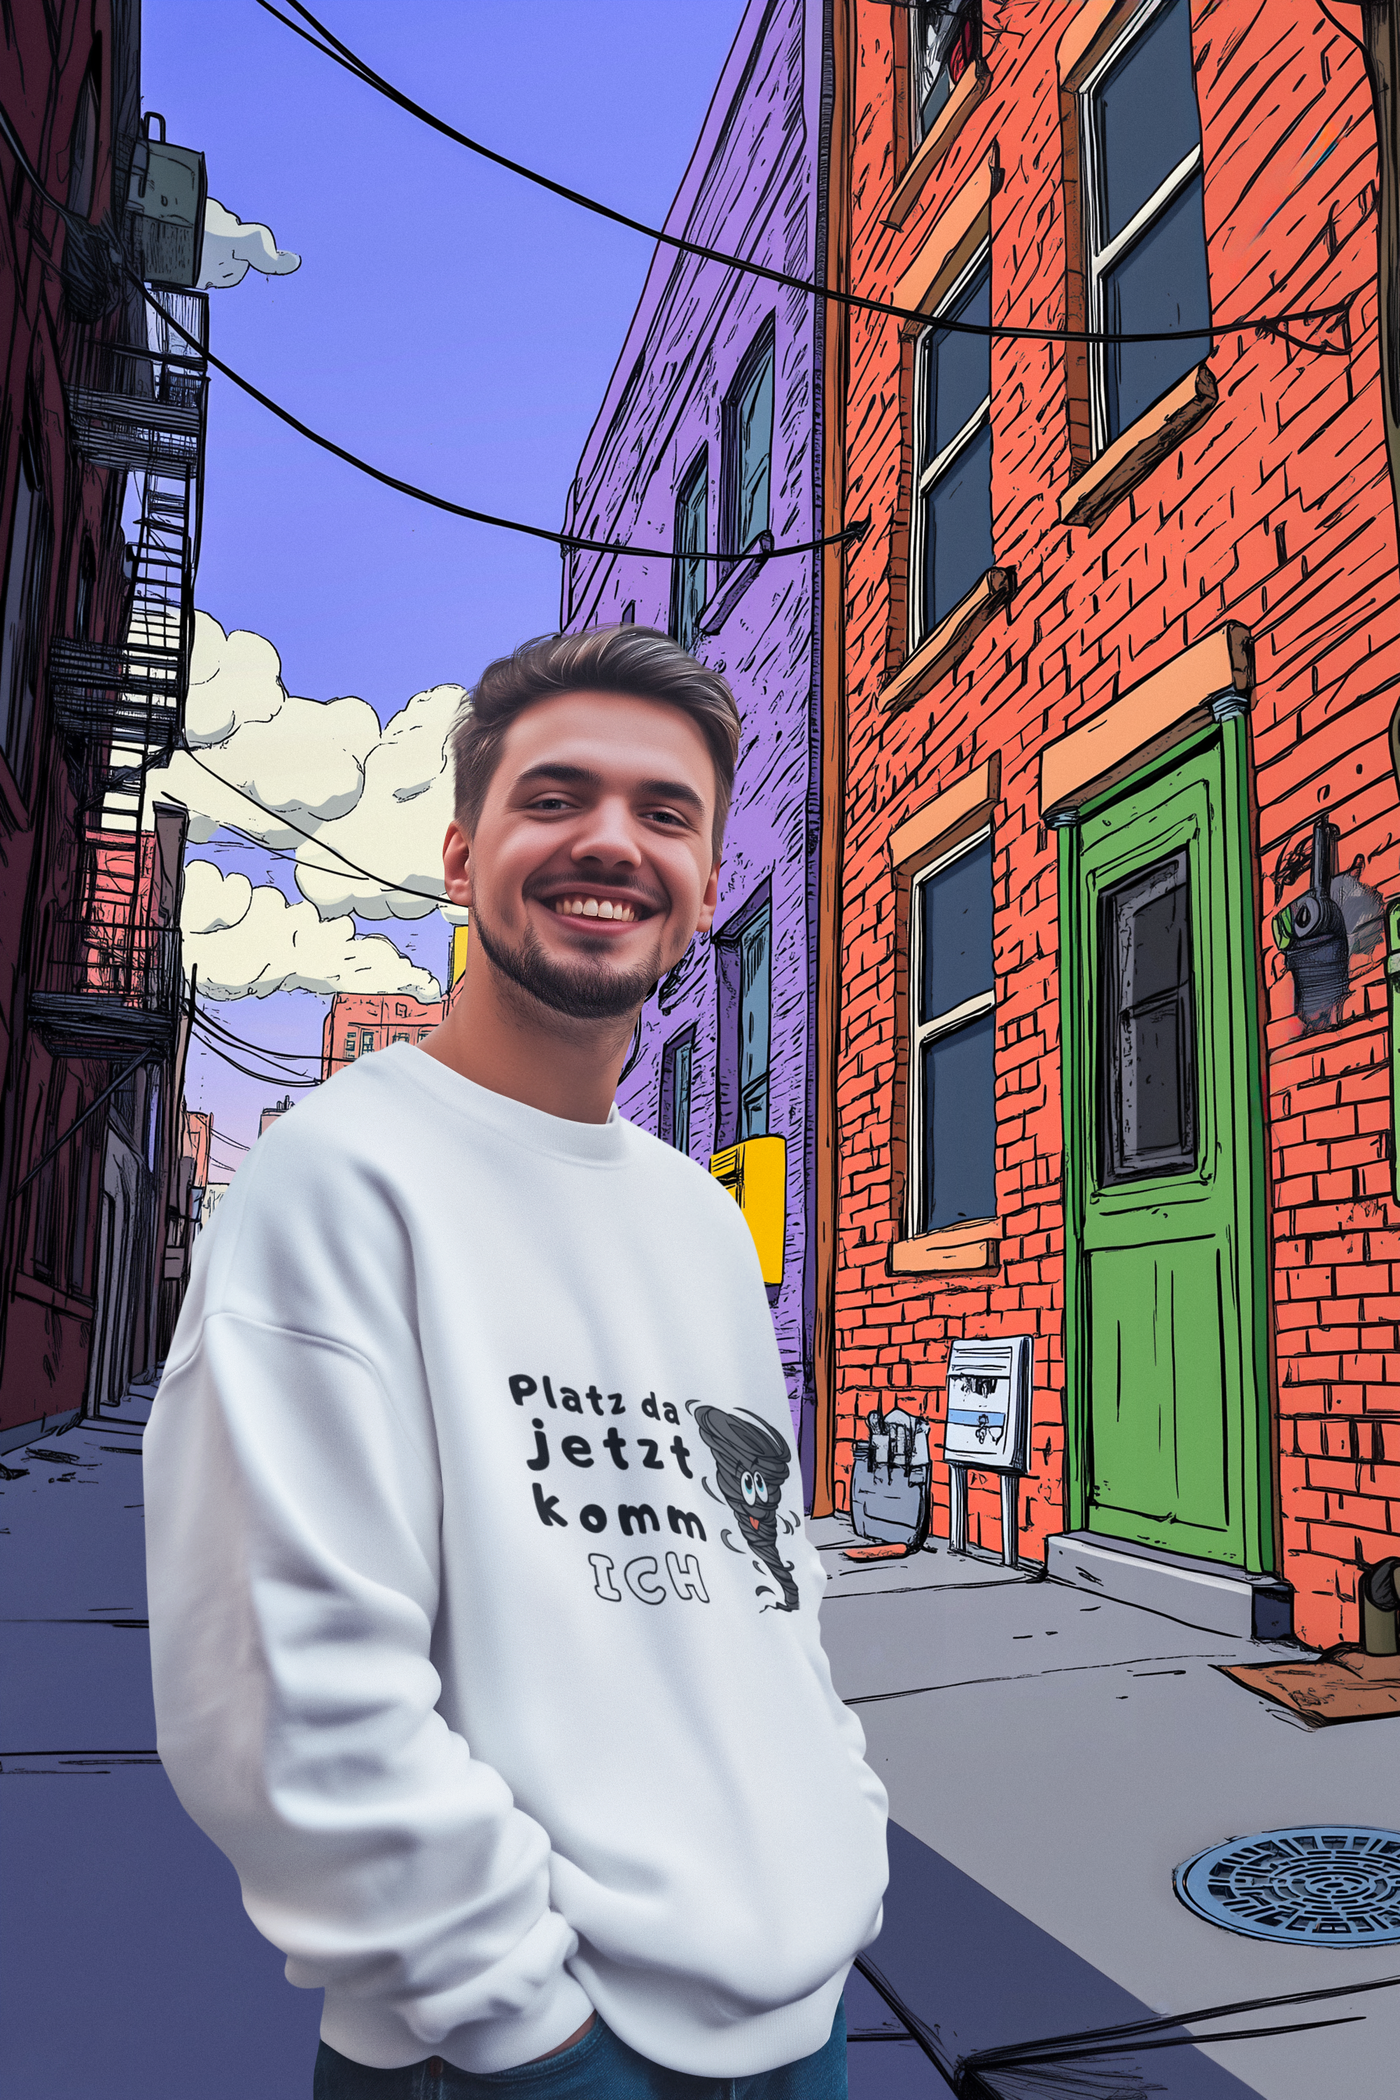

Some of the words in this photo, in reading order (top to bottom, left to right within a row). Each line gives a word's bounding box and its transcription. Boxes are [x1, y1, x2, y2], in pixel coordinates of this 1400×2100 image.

[509, 1374, 626, 1416] Platz
[641, 1391, 680, 1425] da
[526, 1418, 693, 1479] jetzt
[532, 1482, 707, 1542] komm
[588, 1551, 710, 1606] ICH
